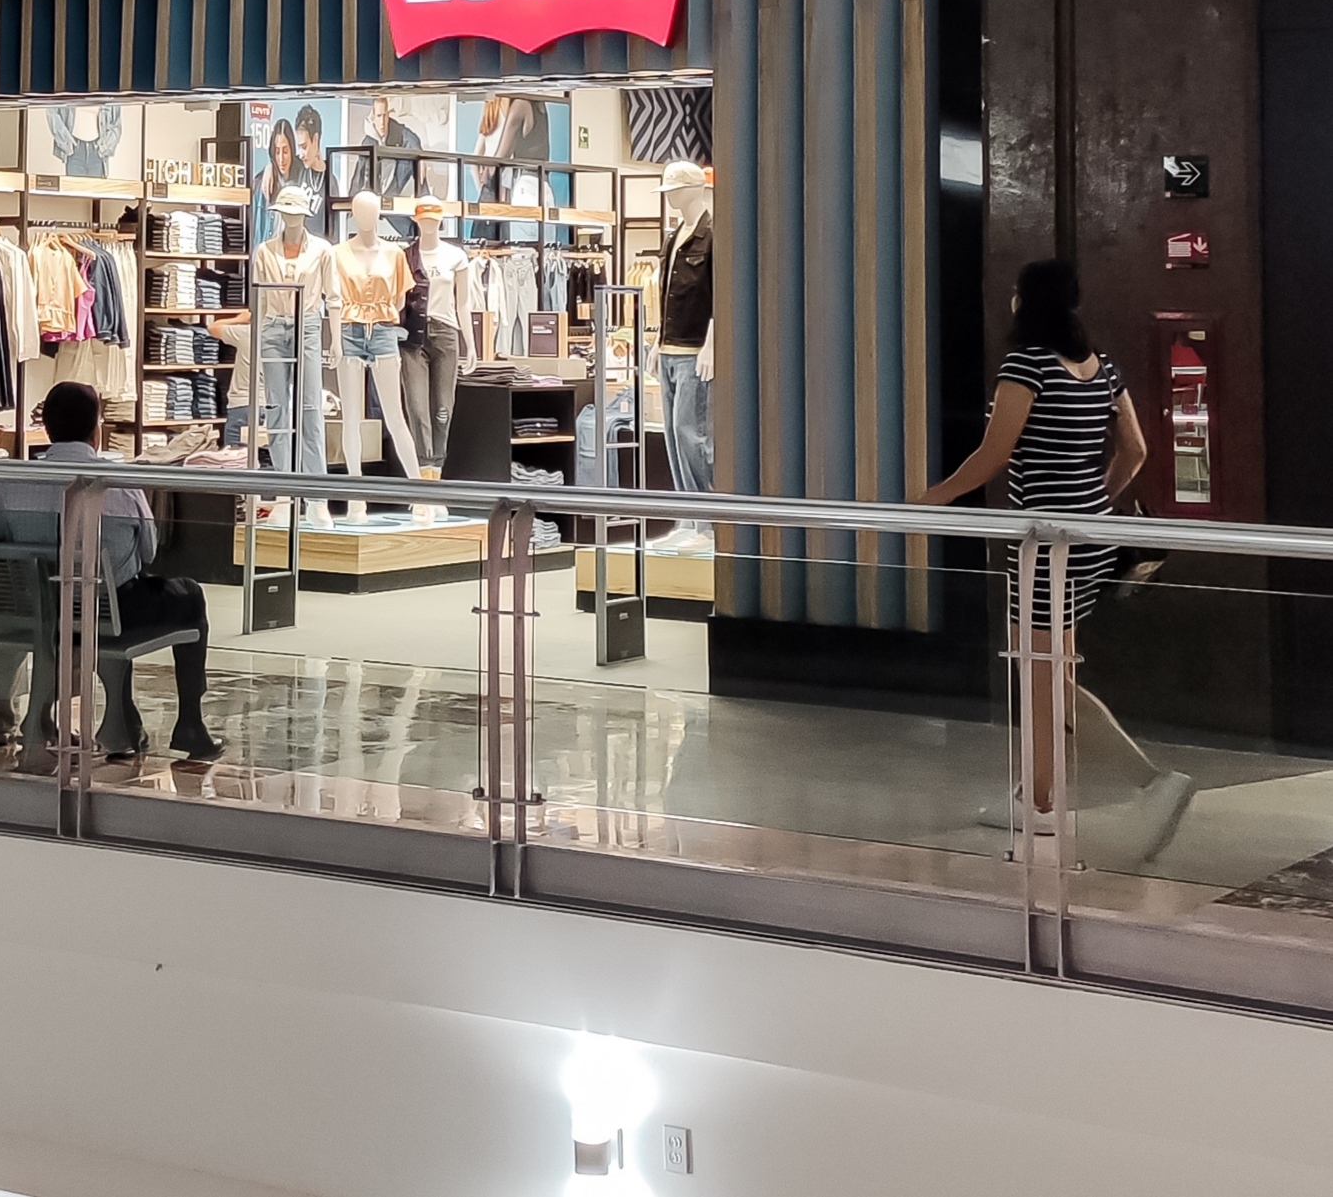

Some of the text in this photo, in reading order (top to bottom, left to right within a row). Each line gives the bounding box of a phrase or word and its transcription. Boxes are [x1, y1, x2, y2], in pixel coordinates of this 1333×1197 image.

[250, 122, 273, 150] 150
[144, 159, 247, 189] HIGH RISE
